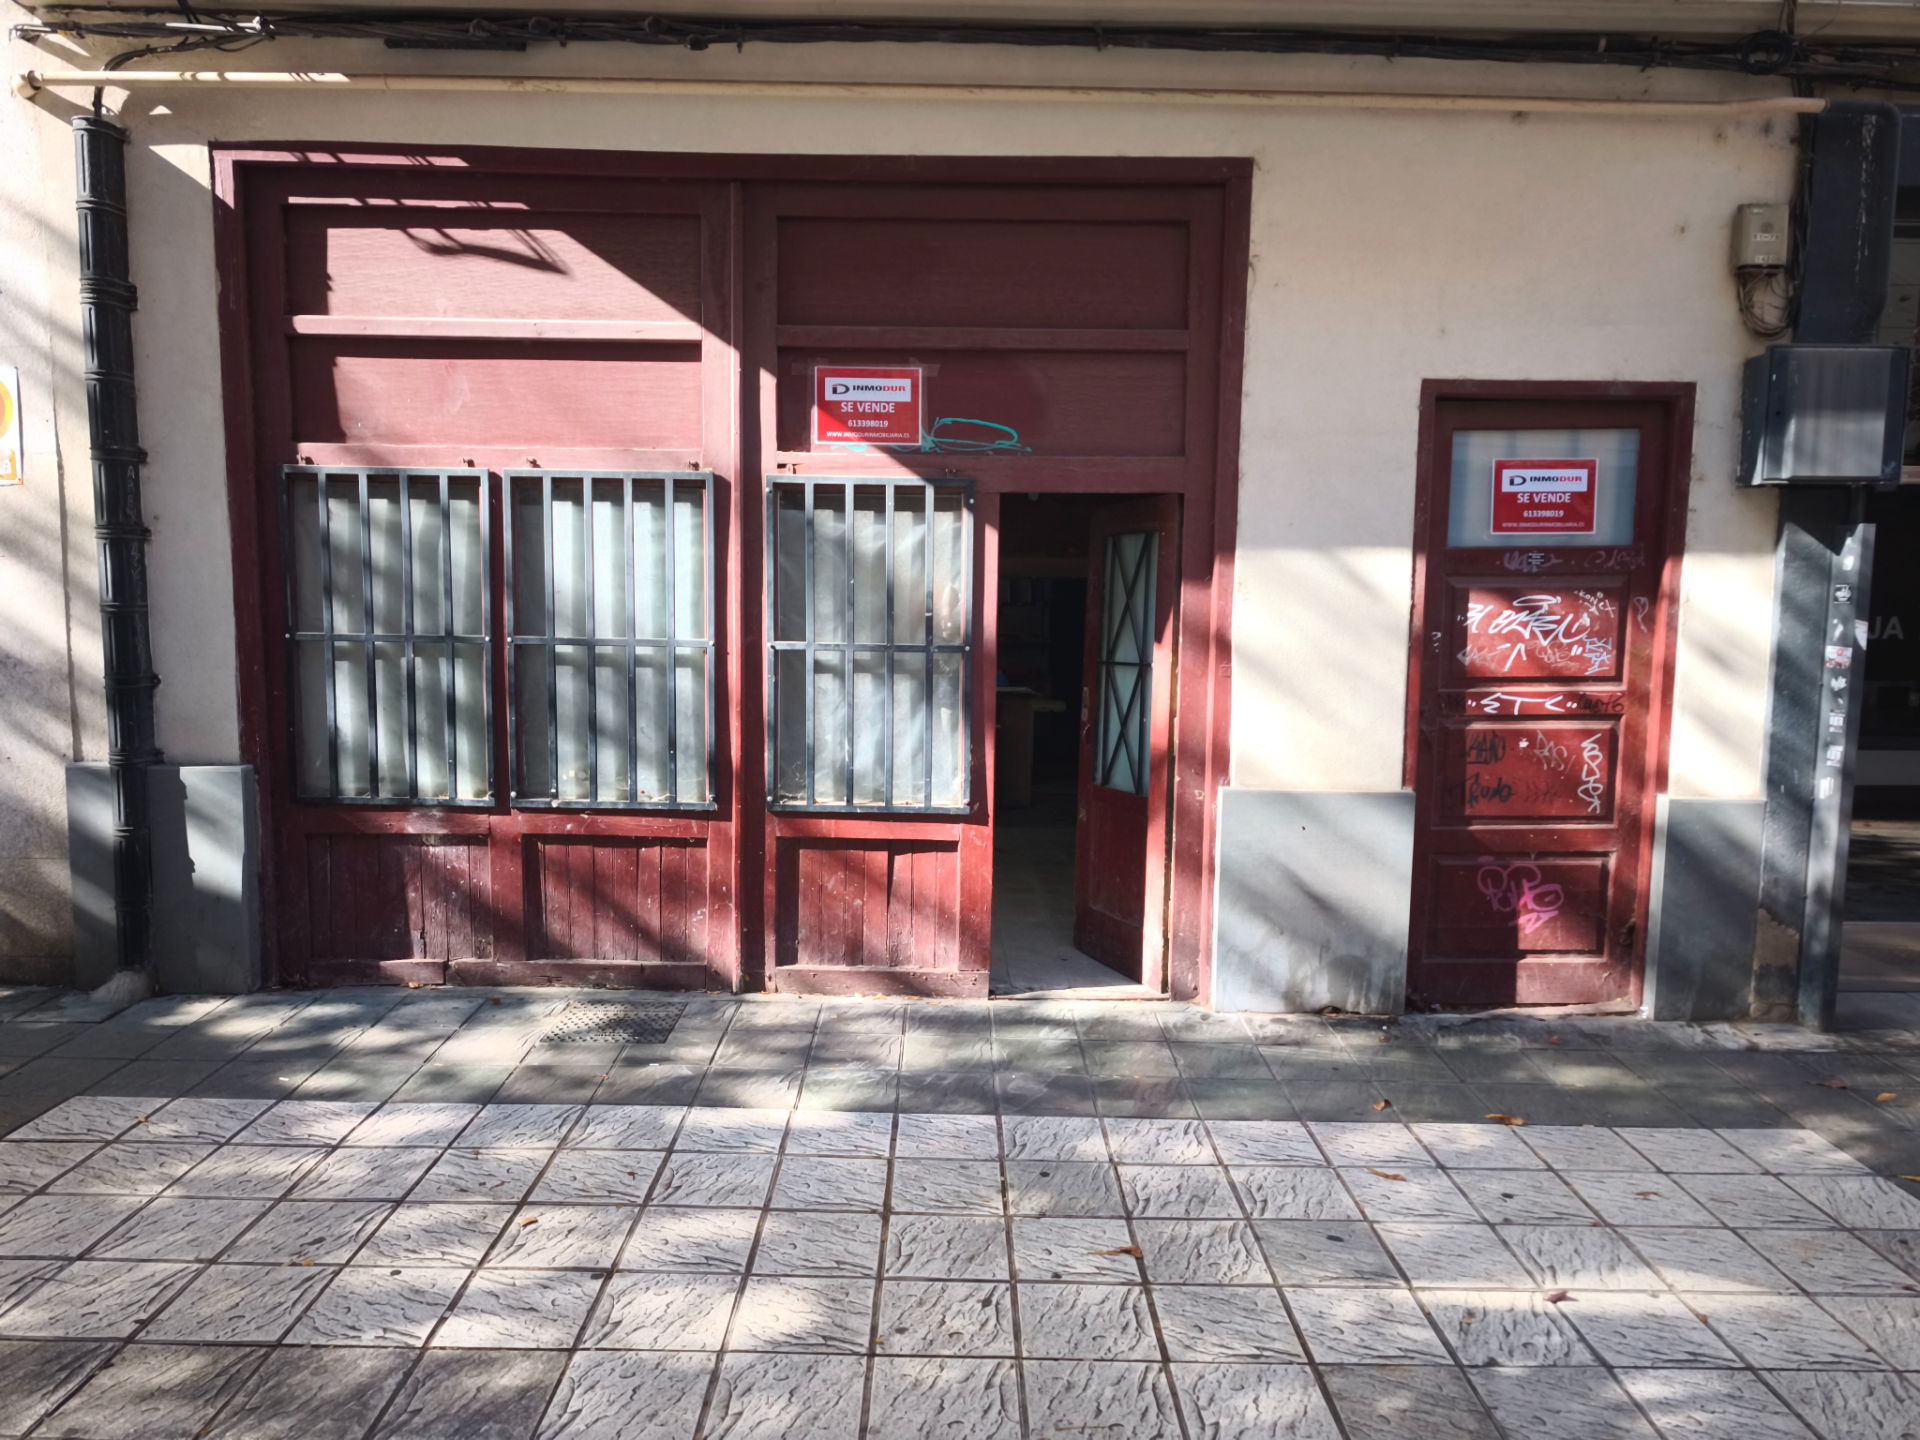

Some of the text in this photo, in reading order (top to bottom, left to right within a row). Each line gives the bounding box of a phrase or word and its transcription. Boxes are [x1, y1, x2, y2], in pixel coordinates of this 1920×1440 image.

[852, 384, 906, 392] INMODUR
[840, 401, 895, 413] SE VENDE
[1517, 492, 1571, 504] SE VENDE
